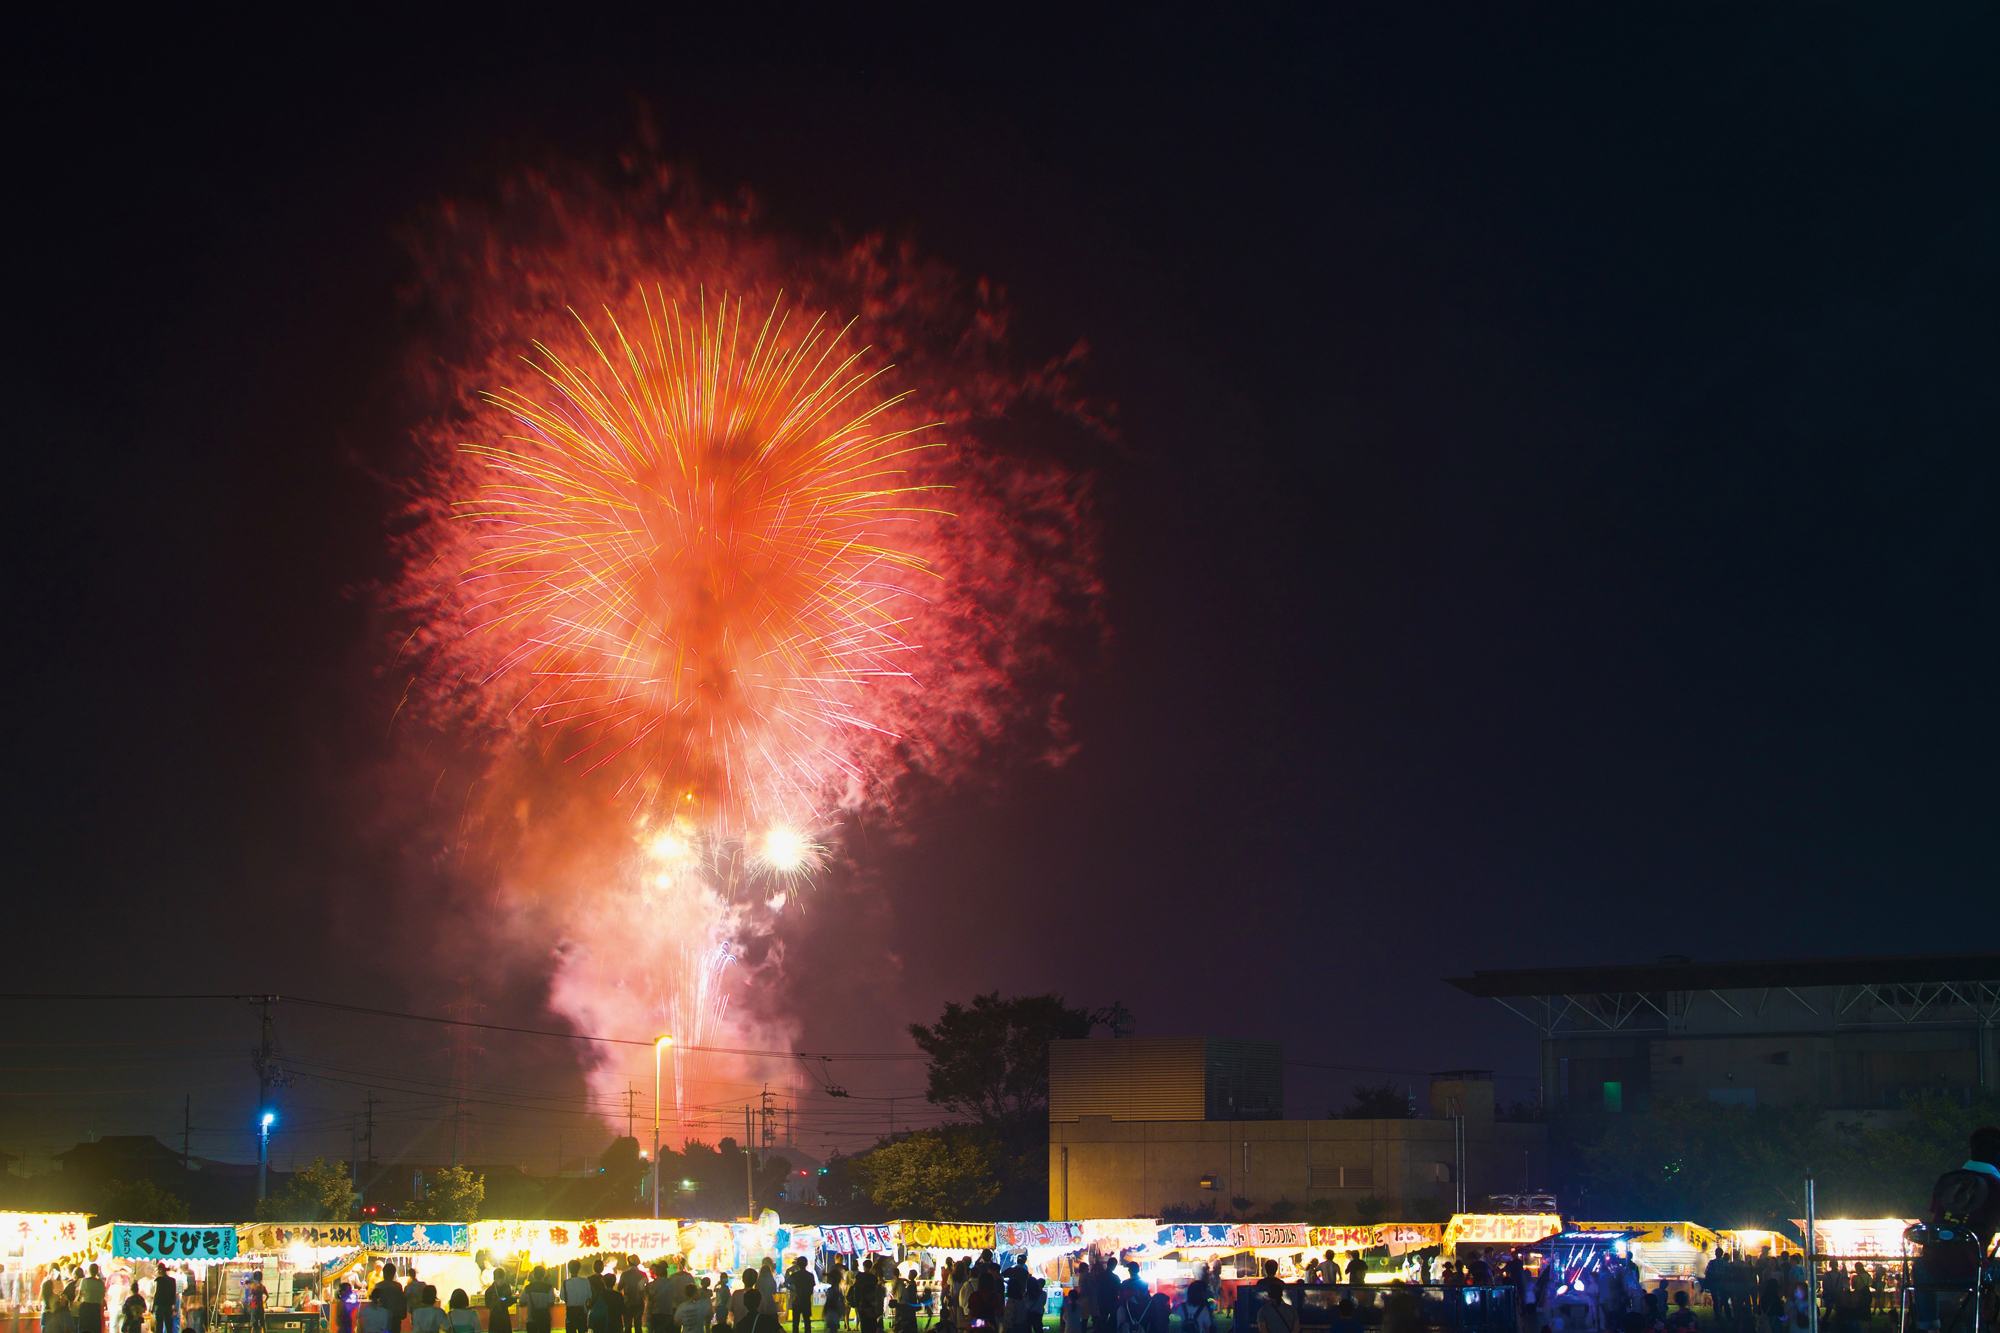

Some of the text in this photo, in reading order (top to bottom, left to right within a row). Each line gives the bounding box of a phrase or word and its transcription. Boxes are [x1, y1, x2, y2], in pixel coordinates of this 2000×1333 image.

[370, 1227, 388, 1246] 氷
[411, 1223, 431, 1246] 氷
[455, 1227, 469, 1246] 氷
[548, 1224, 601, 1249] 串焼
[930, 1223, 990, 1250] 大盛やきそば
[1013, 1226, 1071, 1247] フルーツ飴
[1258, 1228, 1298, 1245] フランクフルト
[1318, 1227, 1369, 1247] スピードくじ
[1462, 1218, 1551, 1240] フライドポテト
[135, 1229, 221, 1256] くじびき
[607, 1231, 671, 1250] ライドポテト
